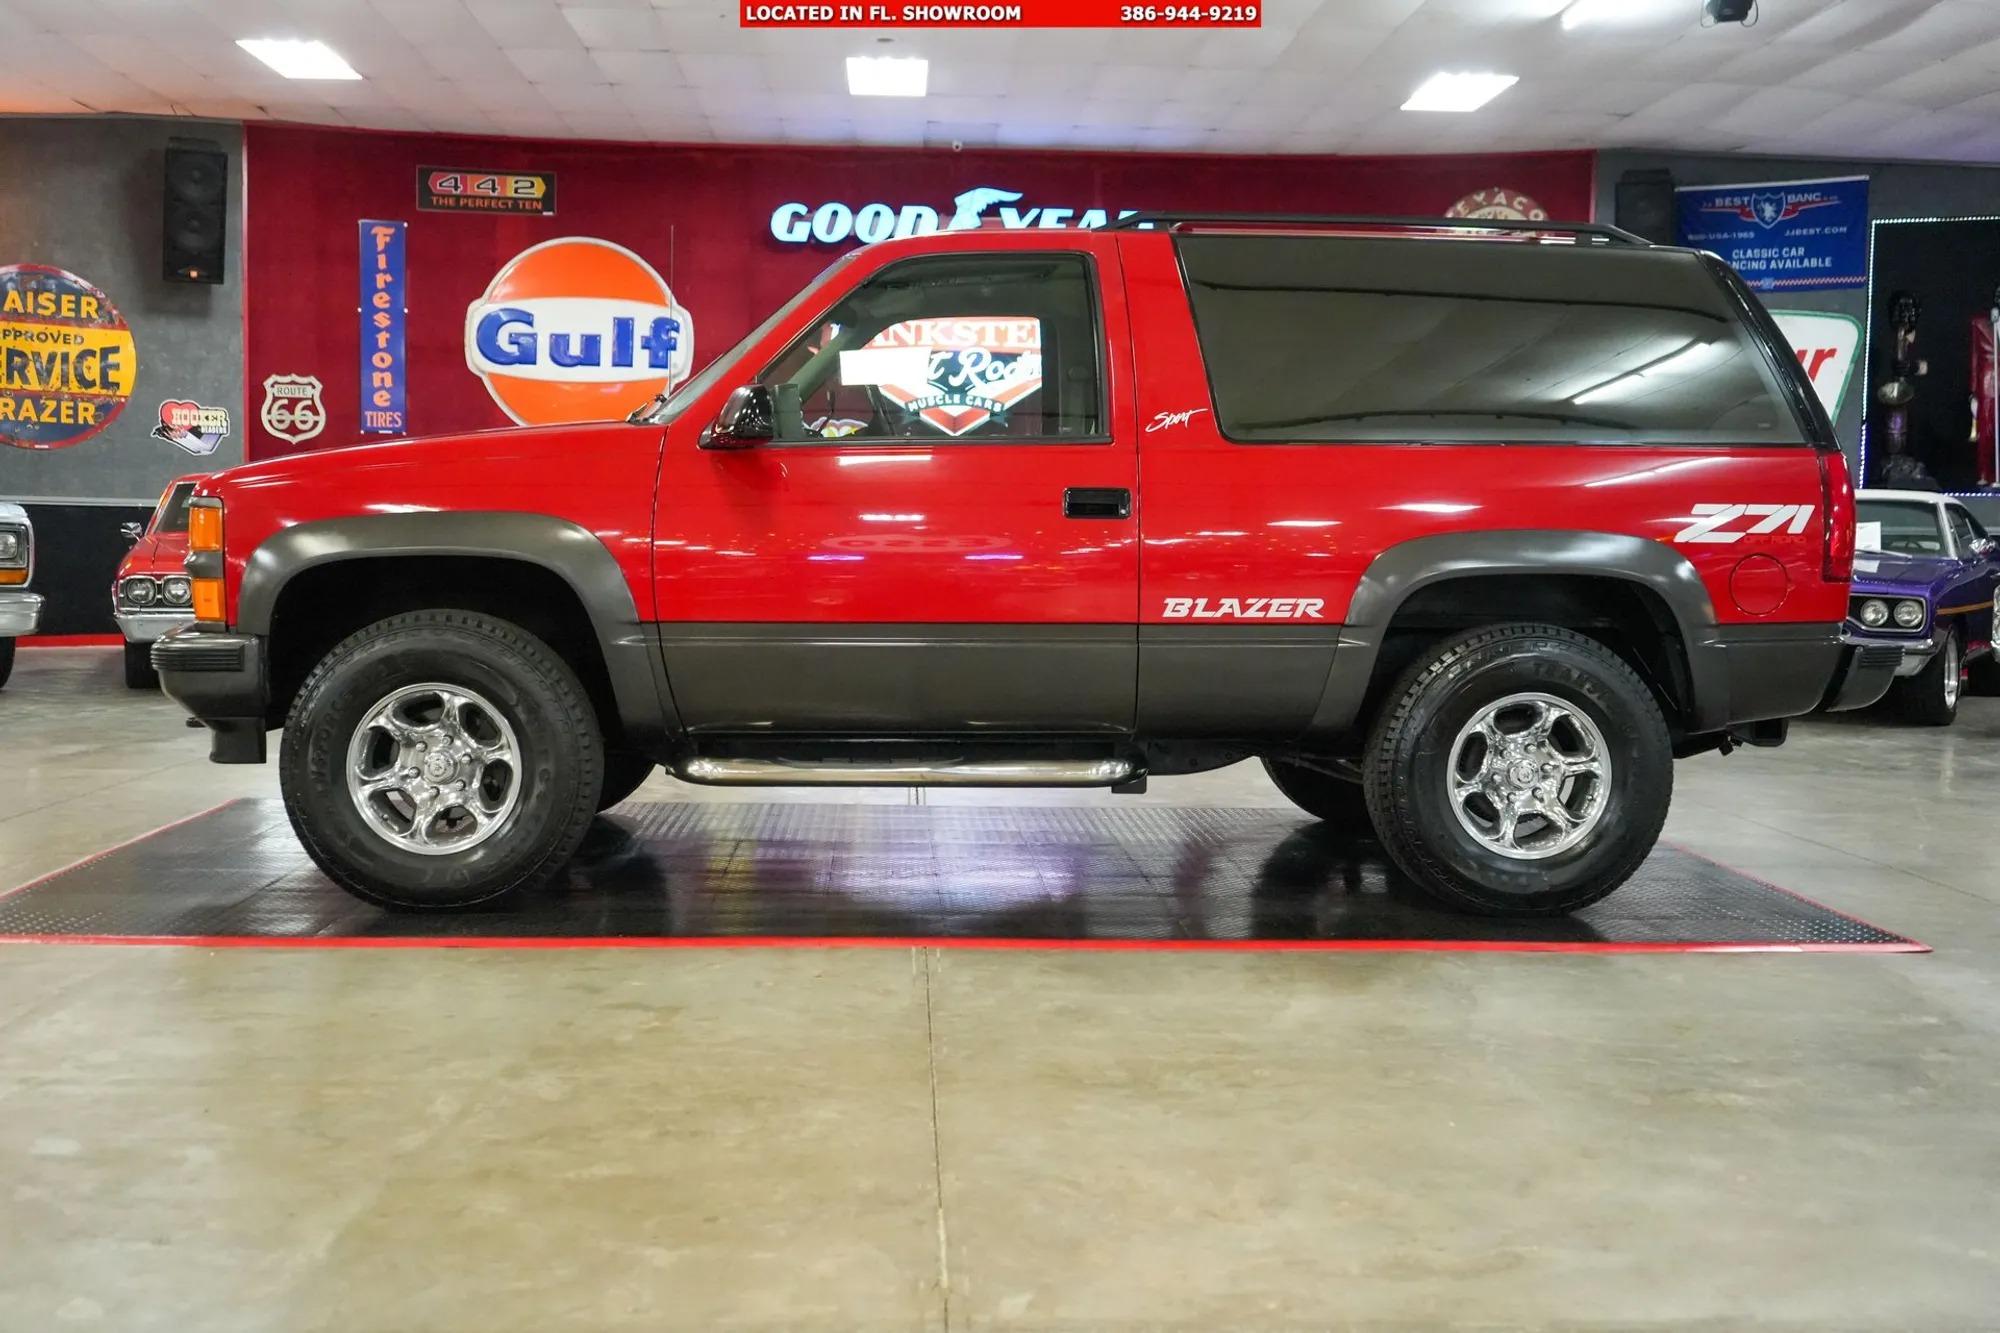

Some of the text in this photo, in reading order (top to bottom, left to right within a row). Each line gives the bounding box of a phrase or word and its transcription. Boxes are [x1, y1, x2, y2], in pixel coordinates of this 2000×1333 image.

[437, 175, 536, 198] 442
[431, 196, 542, 210] THE PERFECT TEN
[1714, 196, 1750, 208] BEST
[1787, 192, 1822, 204] BANC
[1732, 246, 1805, 259] CLASSIC CAR
[1769, 256, 1832, 269] AVAILABLE
[371, 226, 395, 408] Firestone
[476, 308, 681, 369] Gulf
[276, 386, 308, 396] ROUTE
[907, 393, 1002, 412] MUSCLE CARS
[171, 408, 227, 427] HOOKER
[270, 398, 314, 431] 66
[365, 411, 402, 428] TIRES
[1145, 408, 1209, 433] Sport
[1673, 503, 1816, 543] Z71
[1162, 597, 1325, 618] BLAZER
